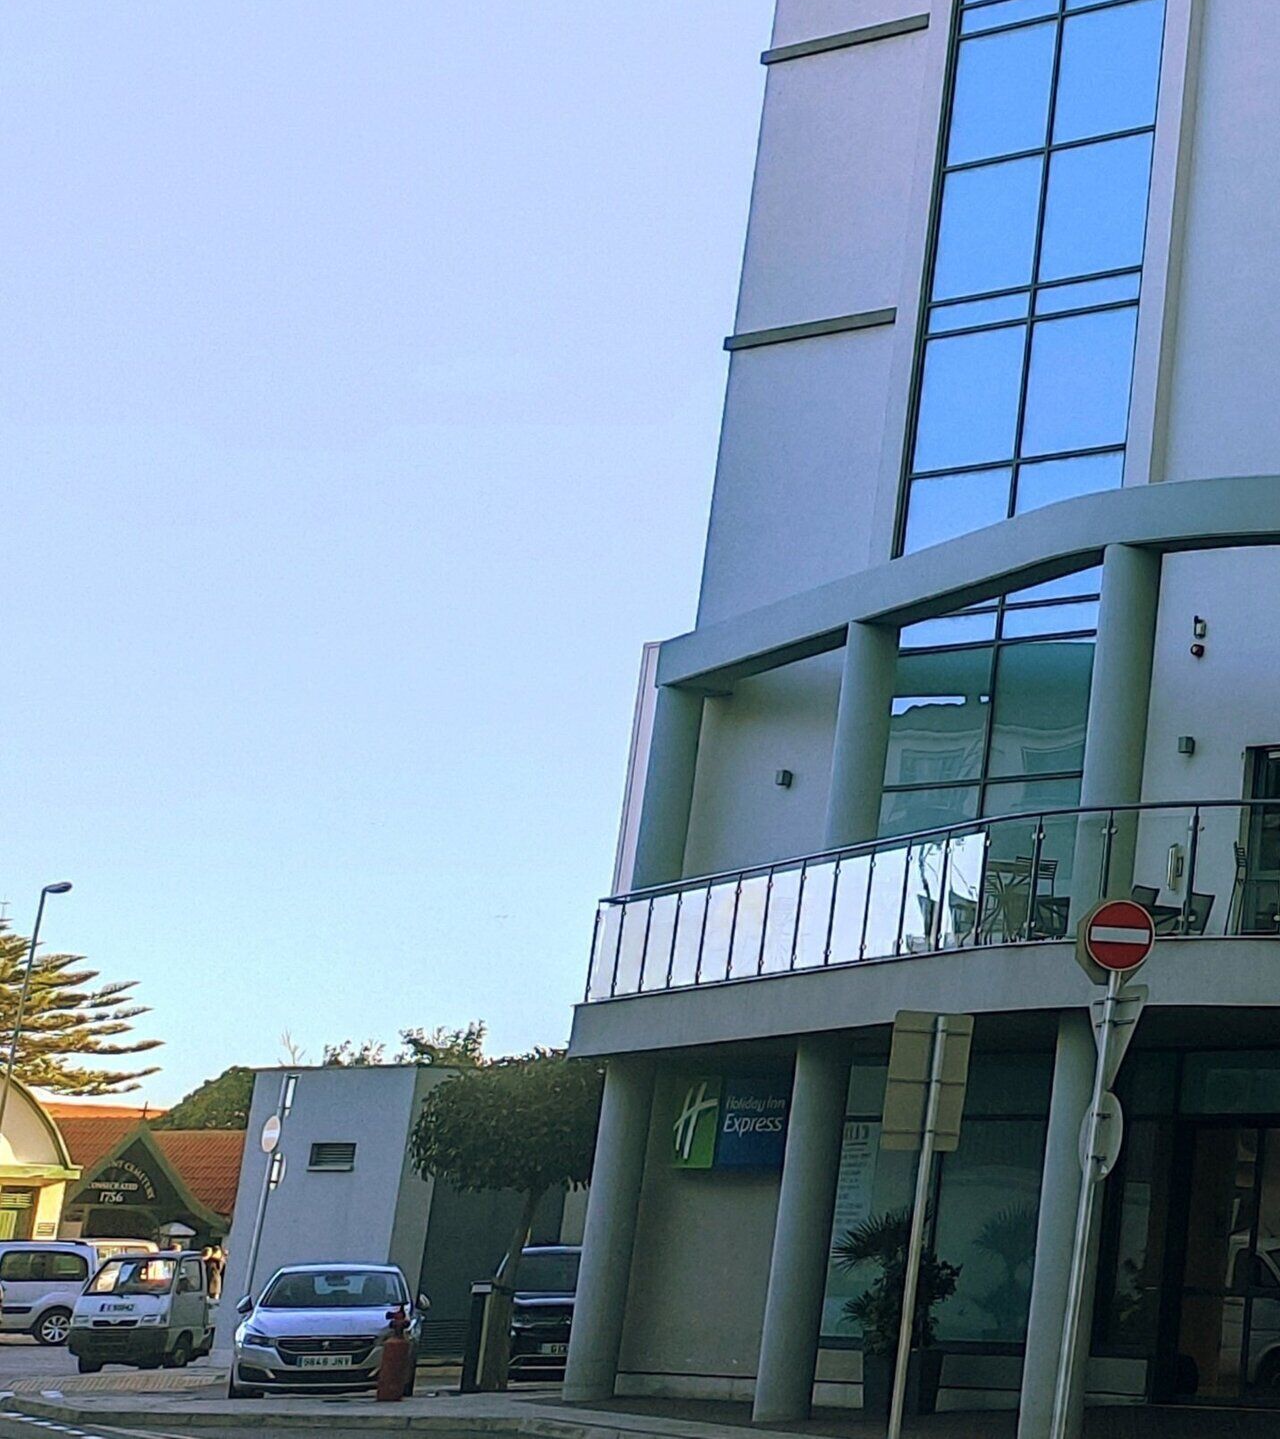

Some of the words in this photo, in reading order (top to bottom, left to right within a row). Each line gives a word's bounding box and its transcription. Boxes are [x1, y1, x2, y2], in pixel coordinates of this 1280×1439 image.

[726, 1095, 765, 1112] Holiday
[766, 1096, 785, 1109] Inn
[723, 1113, 784, 1138] Express
[99, 1191, 124, 1203] 1756
